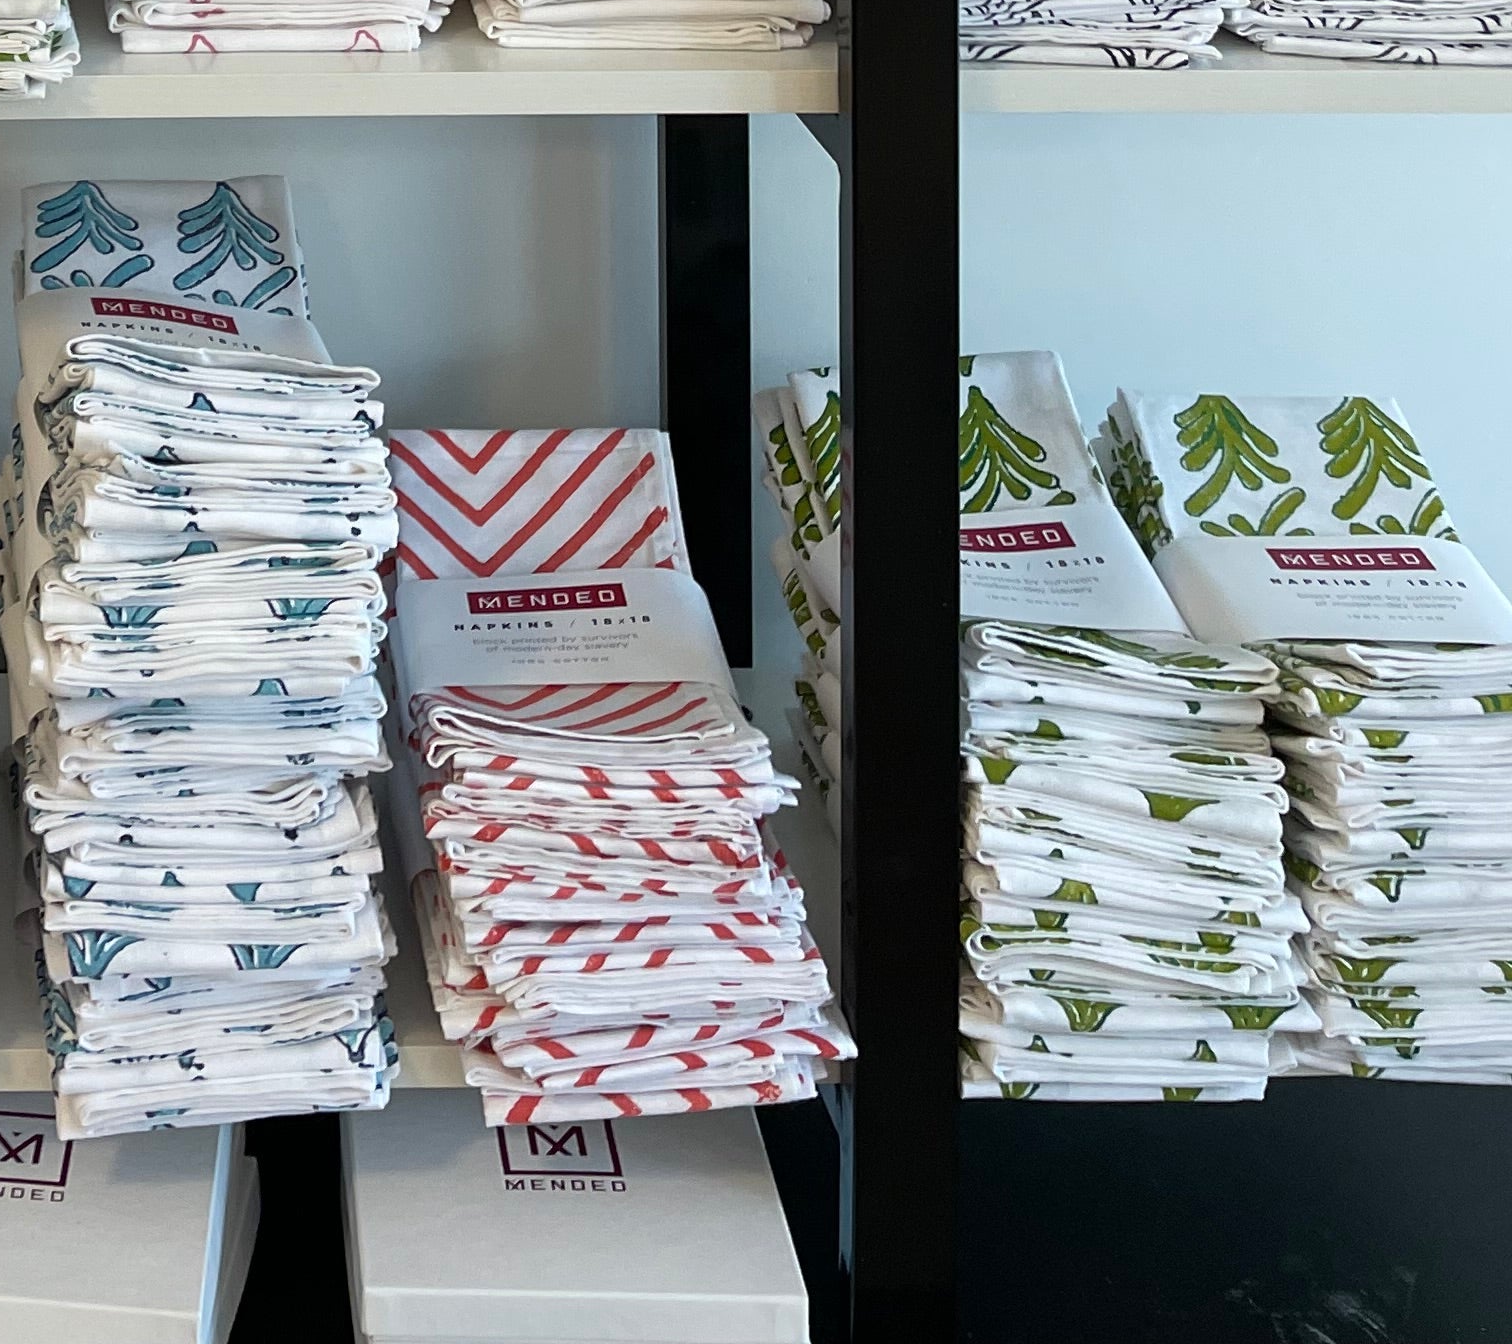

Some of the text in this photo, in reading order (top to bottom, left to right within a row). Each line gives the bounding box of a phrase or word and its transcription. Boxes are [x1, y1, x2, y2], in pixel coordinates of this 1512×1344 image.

[102, 301, 228, 330] MENDED
[960, 529, 1061, 547] ENDED
[1280, 552, 1421, 566] MENDED
[478, 589, 616, 609] MENDED
[454, 620, 553, 631] NAPKINS
[504, 1179, 627, 1192] MENDED
